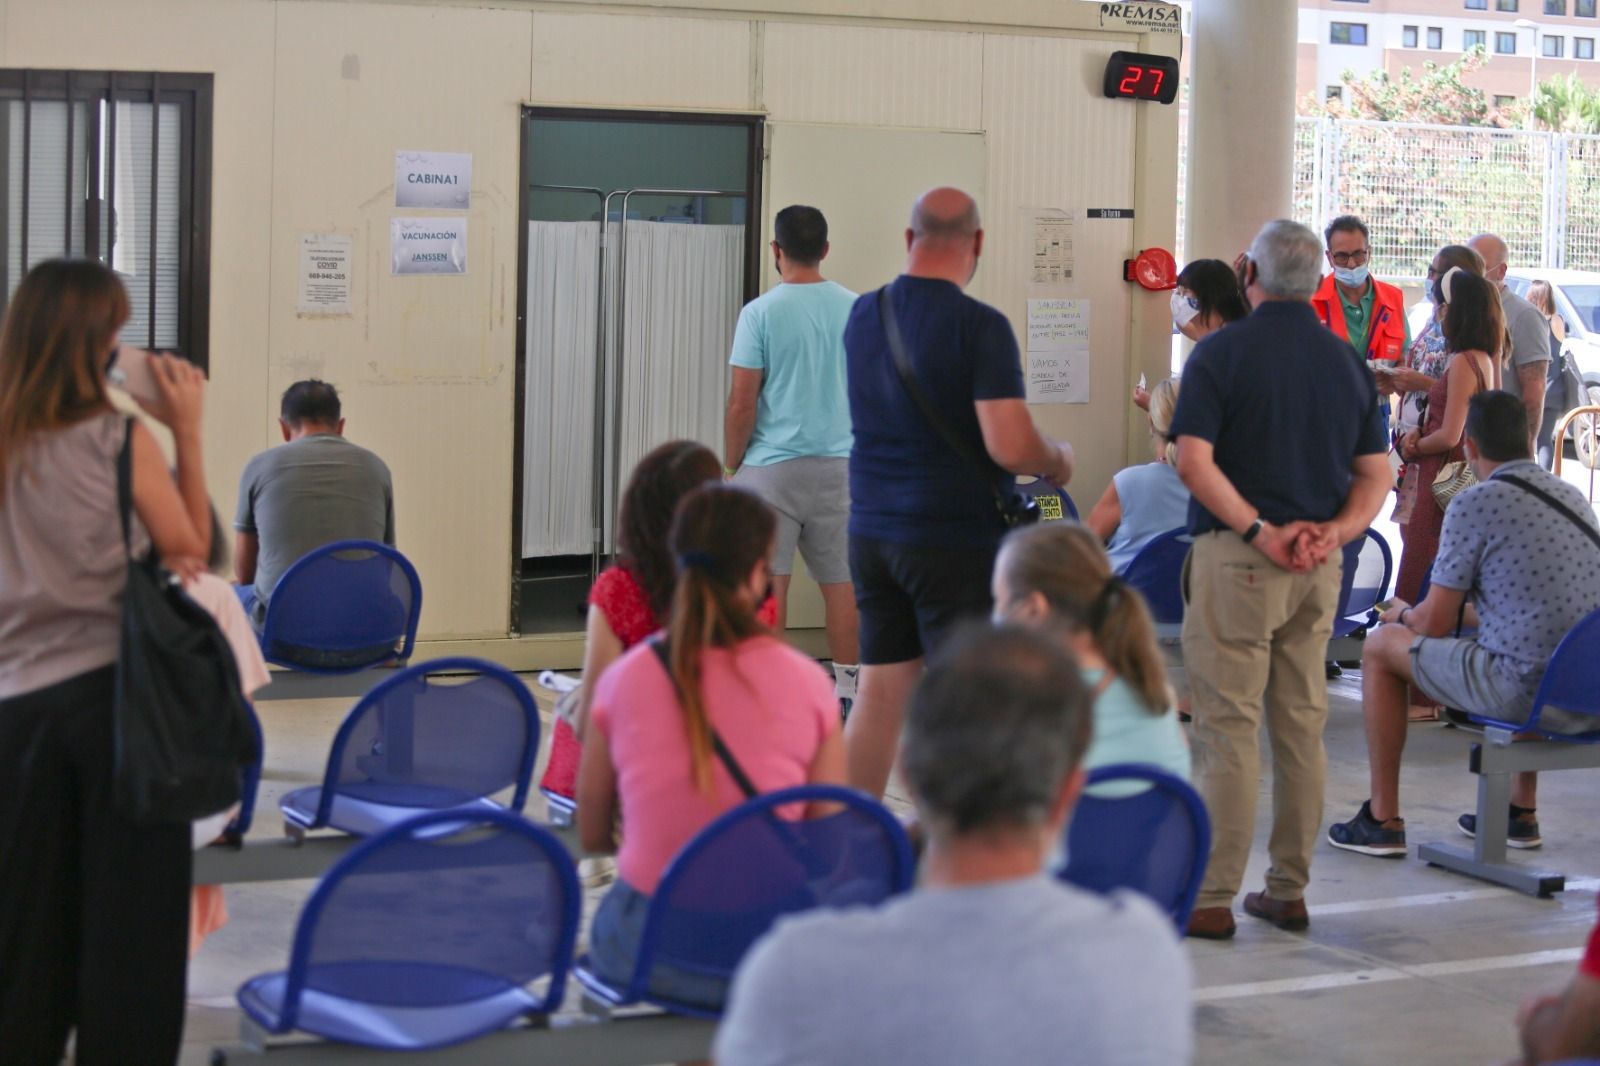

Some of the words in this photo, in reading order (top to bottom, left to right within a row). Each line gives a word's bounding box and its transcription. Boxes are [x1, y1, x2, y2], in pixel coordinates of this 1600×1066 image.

[1108, 4, 1179, 21] REMSA
[1125, 19, 1179, 28] www.remsa.net
[1119, 66, 1164, 95] 27
[401, 231, 457, 240] VACUNACIÓN
[411, 252, 448, 261] JANSSEN
[317, 261, 338, 269] COVID
[1031, 359, 1059, 368] VAMOS
[1064, 359, 1071, 368] X
